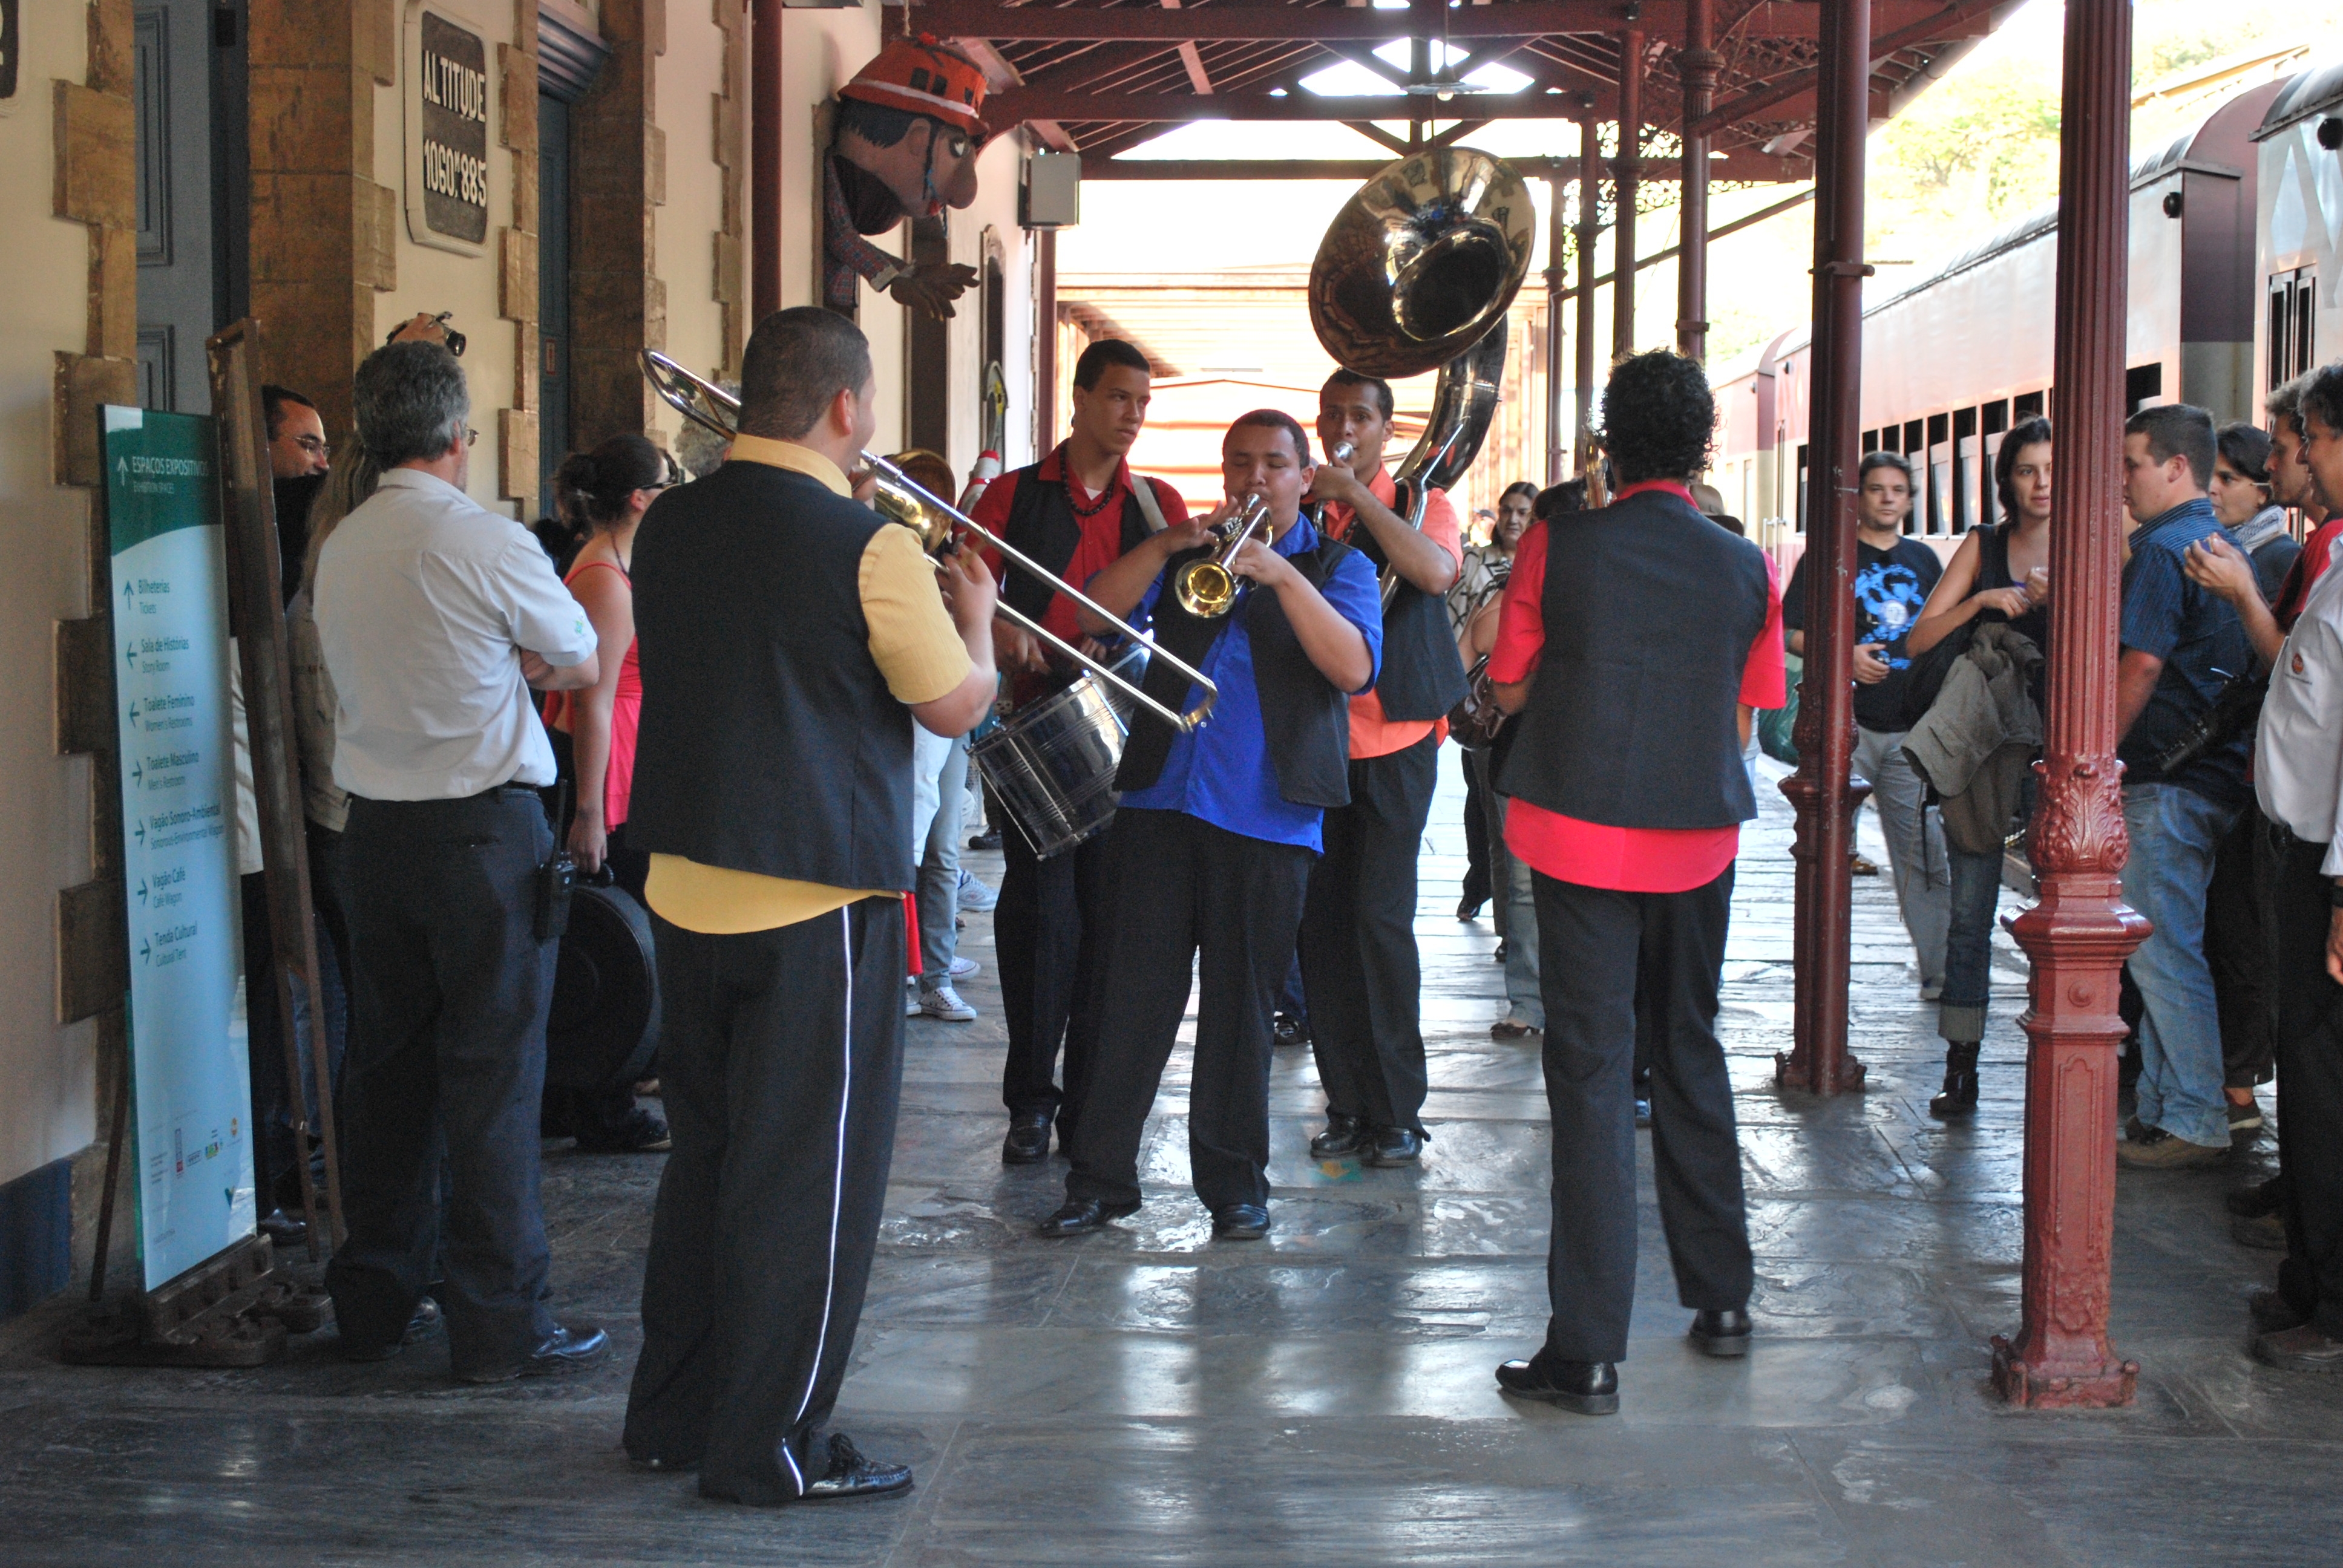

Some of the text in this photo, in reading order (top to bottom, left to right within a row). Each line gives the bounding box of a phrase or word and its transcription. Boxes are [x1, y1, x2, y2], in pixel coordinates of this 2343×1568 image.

[424, 50, 486, 122] ALTITUDE
[132, 456, 165, 478] ESPAÇOS
[139, 579, 170, 594] Bilheterias
[141, 636, 189, 653] Sala de Histórias
[152, 866, 186, 890] Vagão Café
[154, 920, 198, 946] Tenda Cultural
